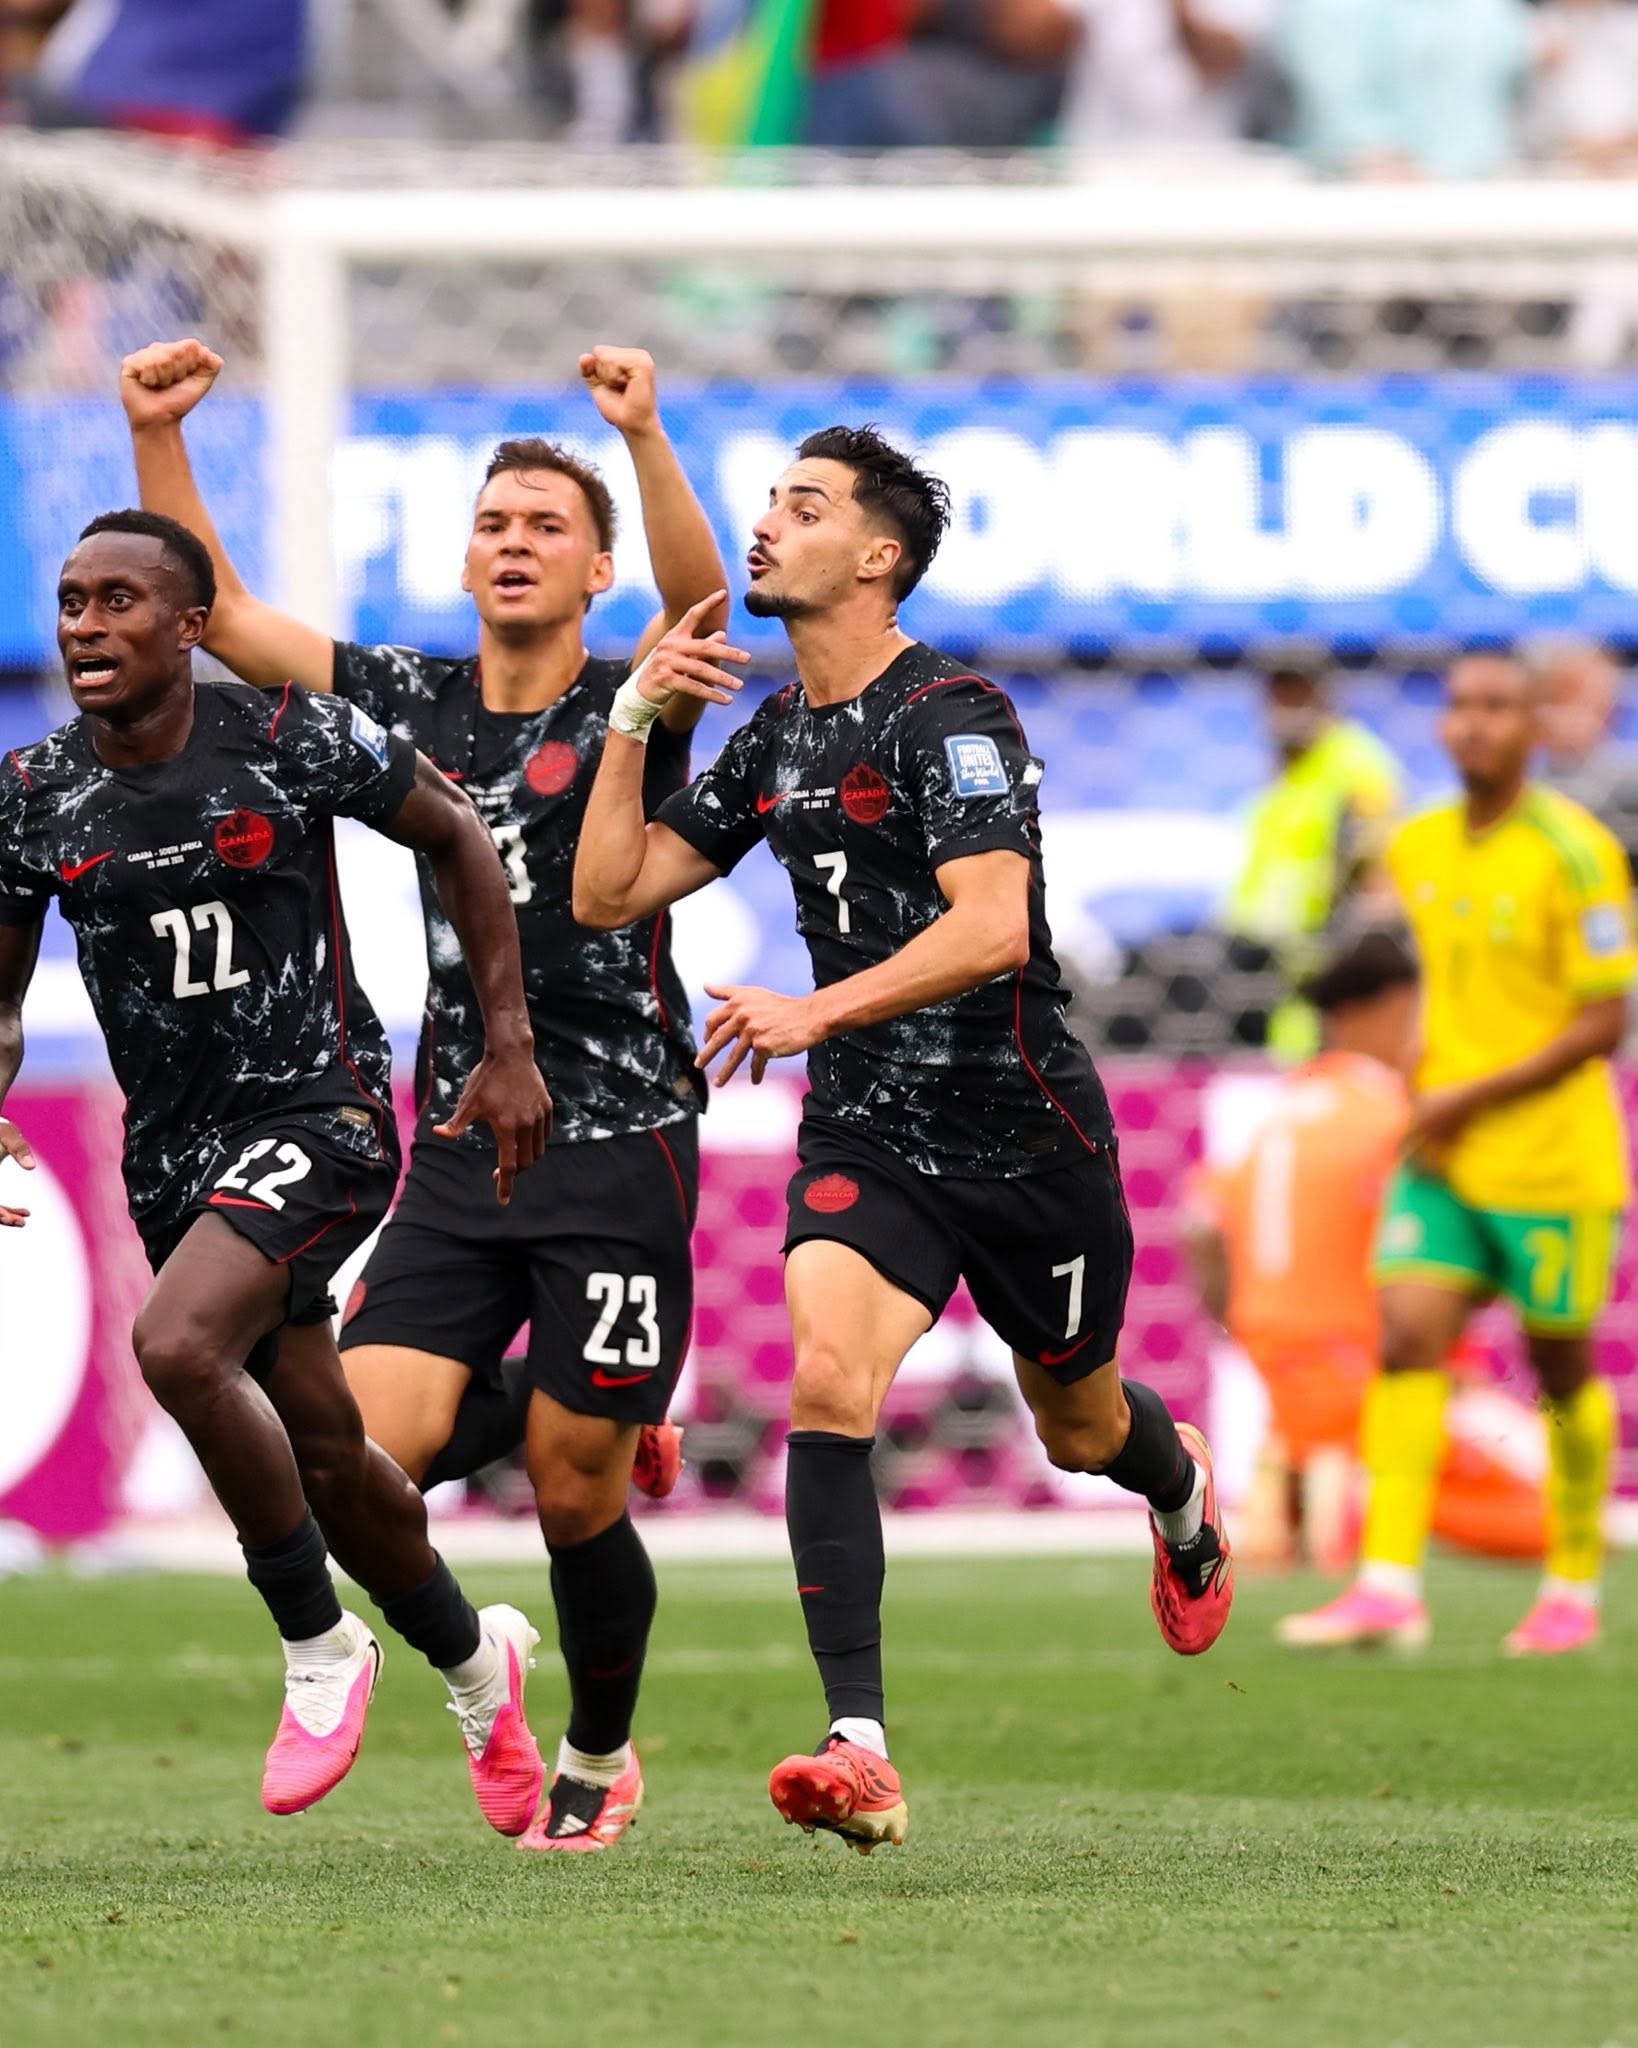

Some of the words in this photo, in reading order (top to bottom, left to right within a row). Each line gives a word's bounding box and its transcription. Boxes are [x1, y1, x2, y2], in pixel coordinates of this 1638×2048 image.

[843, 787, 887, 801] CANADA
[218, 831, 271, 848] CANADA
[491, 825, 532, 903] 3
[813, 850, 850, 934] 7
[150, 900, 251, 999] 22
[213, 1138, 313, 1212] 22
[583, 1271, 661, 1367] 23
[1051, 1254, 1086, 1339] 7
